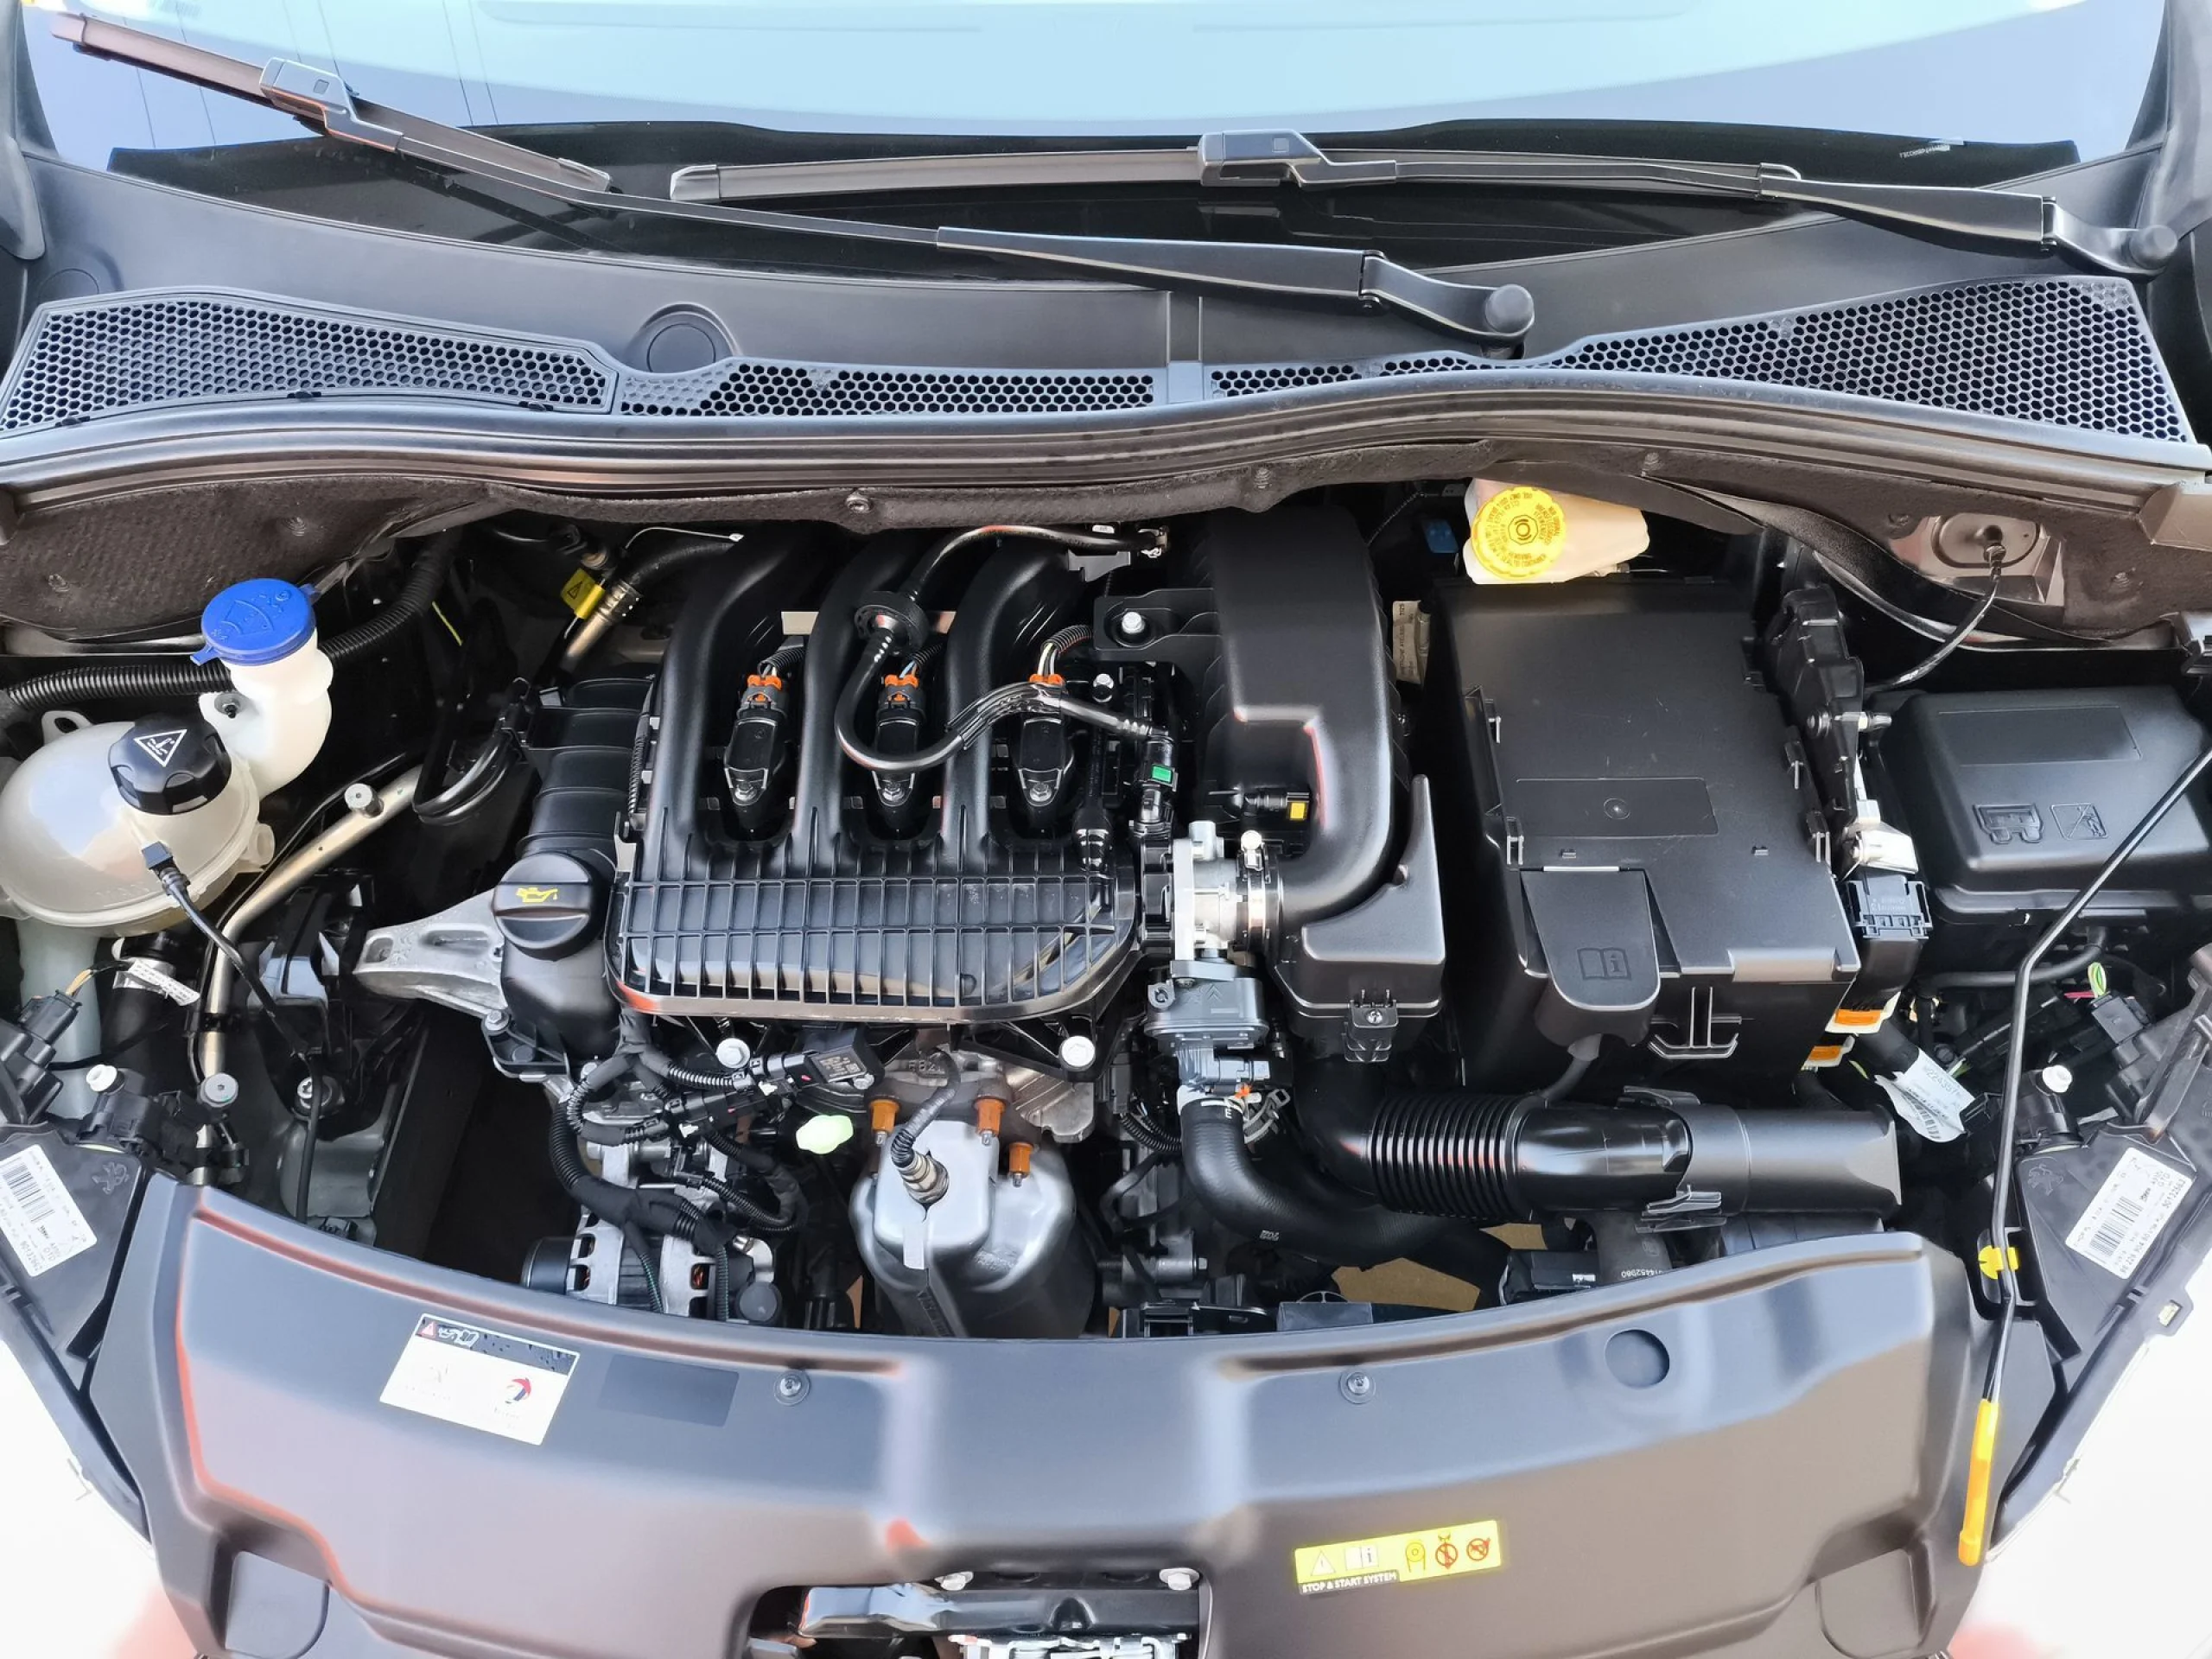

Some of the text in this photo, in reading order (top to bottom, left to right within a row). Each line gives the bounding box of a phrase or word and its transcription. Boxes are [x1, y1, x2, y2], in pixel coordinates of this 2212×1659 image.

[1302, 1581, 1325, 1592] STOP
[1334, 1576, 1363, 1588] START
[1363, 1571, 1397, 1584] SYSTEM
